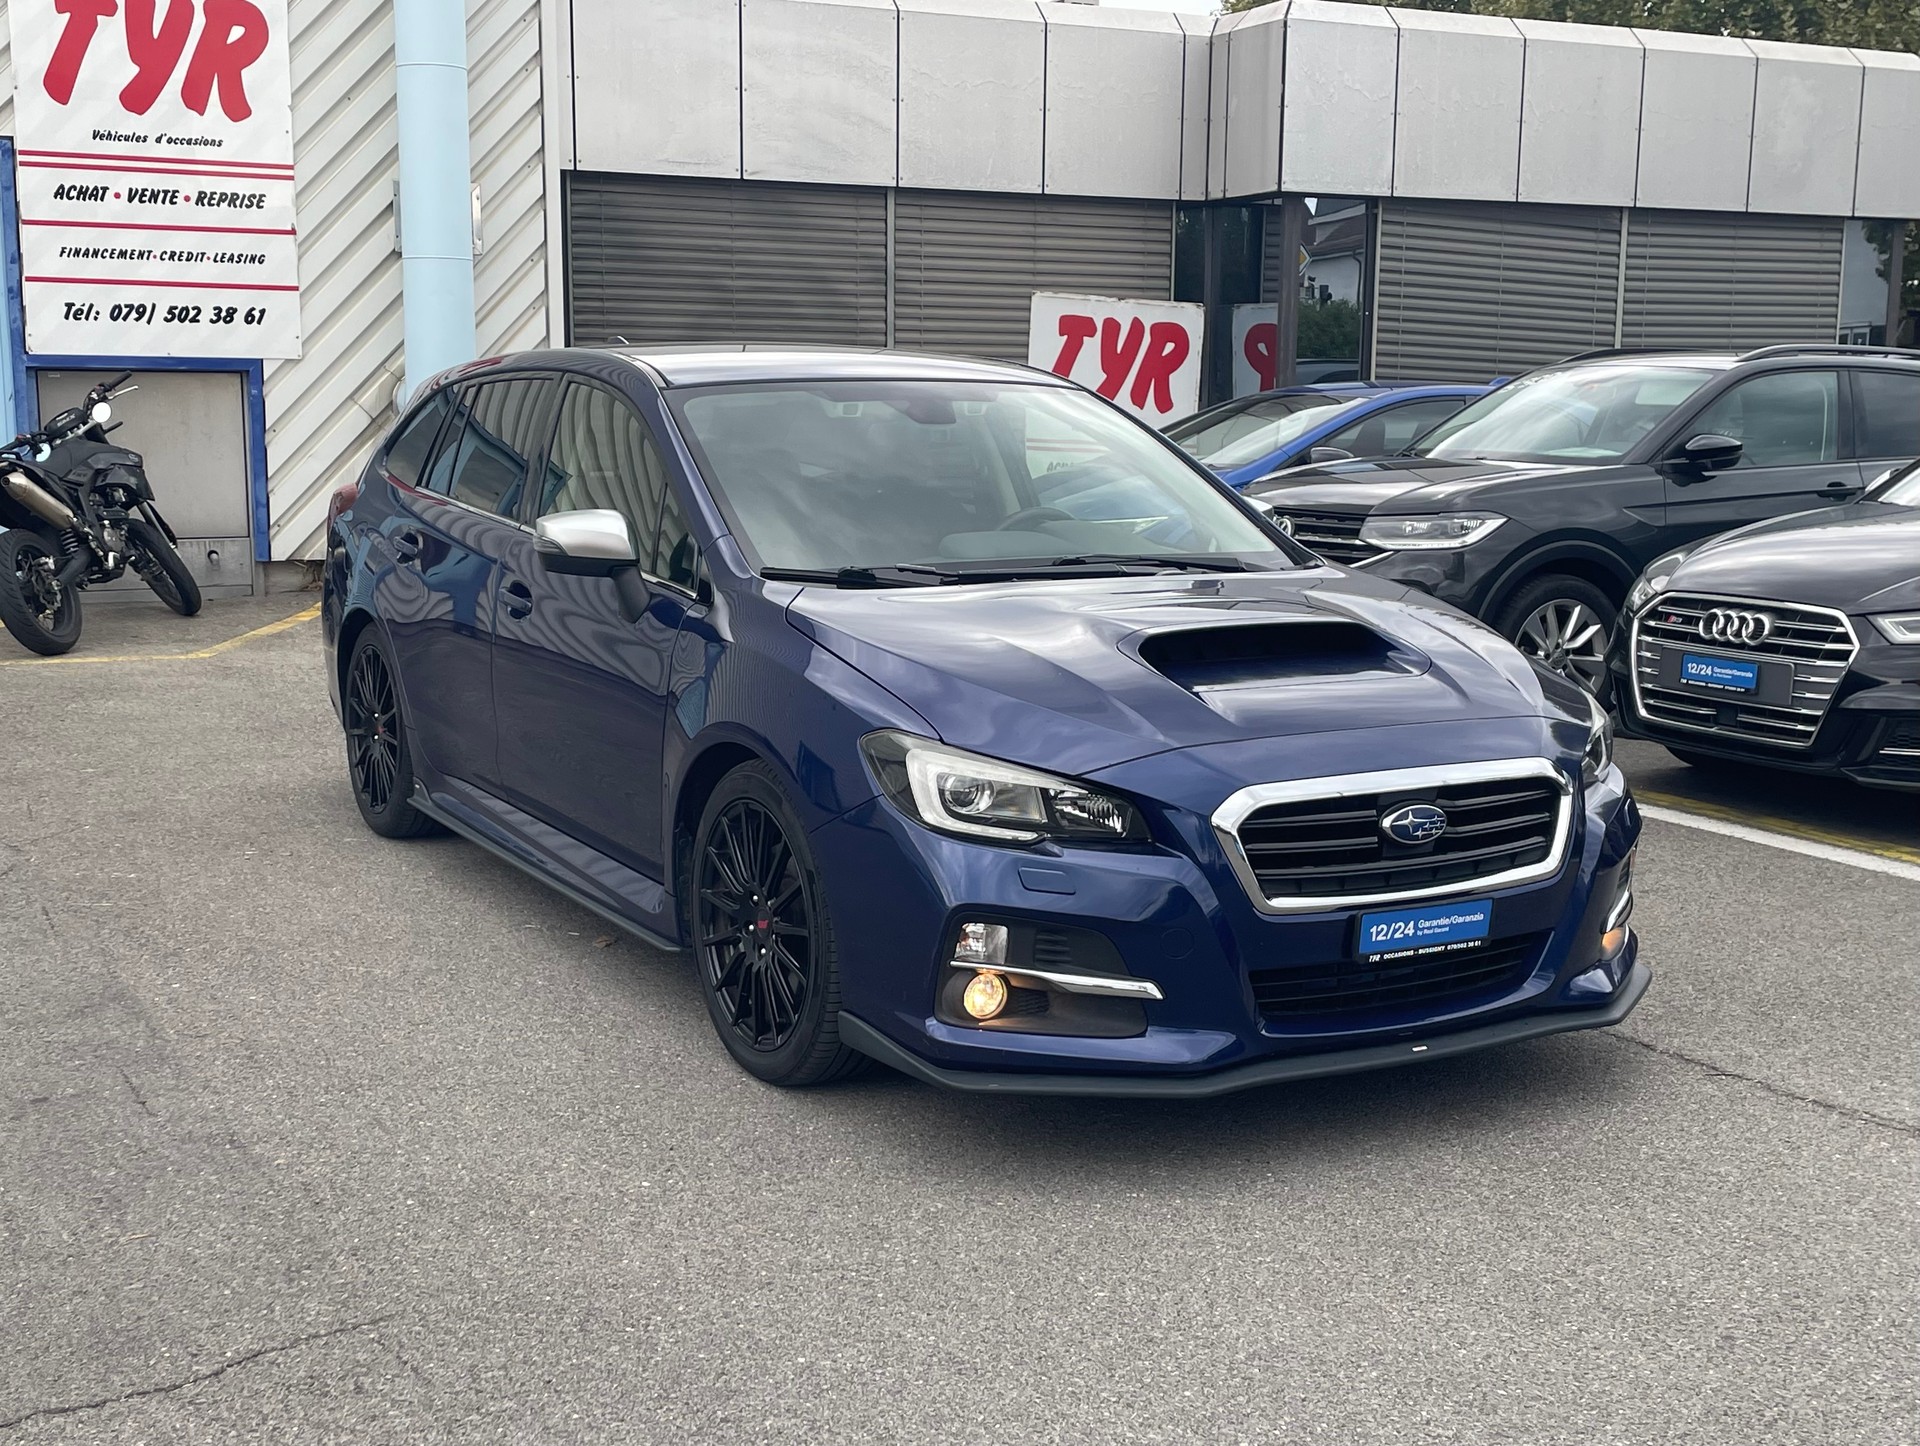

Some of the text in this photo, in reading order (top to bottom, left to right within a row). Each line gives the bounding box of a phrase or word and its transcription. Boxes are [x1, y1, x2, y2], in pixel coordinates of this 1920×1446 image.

[43, 0, 269, 122] TYR
[92, 129, 223, 147] Véhicules d'occasions
[53, 184, 266, 210] ACHAT VENTE REPRISE
[59, 246, 266, 265] FINANCEMENT CREDIT LEASING
[63, 302, 100, 321] Tél:
[163, 305, 201, 324] 502
[209, 306, 238, 325] 38
[243, 307, 266, 325] 61
[1052, 314, 1190, 415] TYR
[1687, 662, 1712, 676] 12/24
[1370, 912, 1484, 942] 12/24 Garantie/Garanzia
